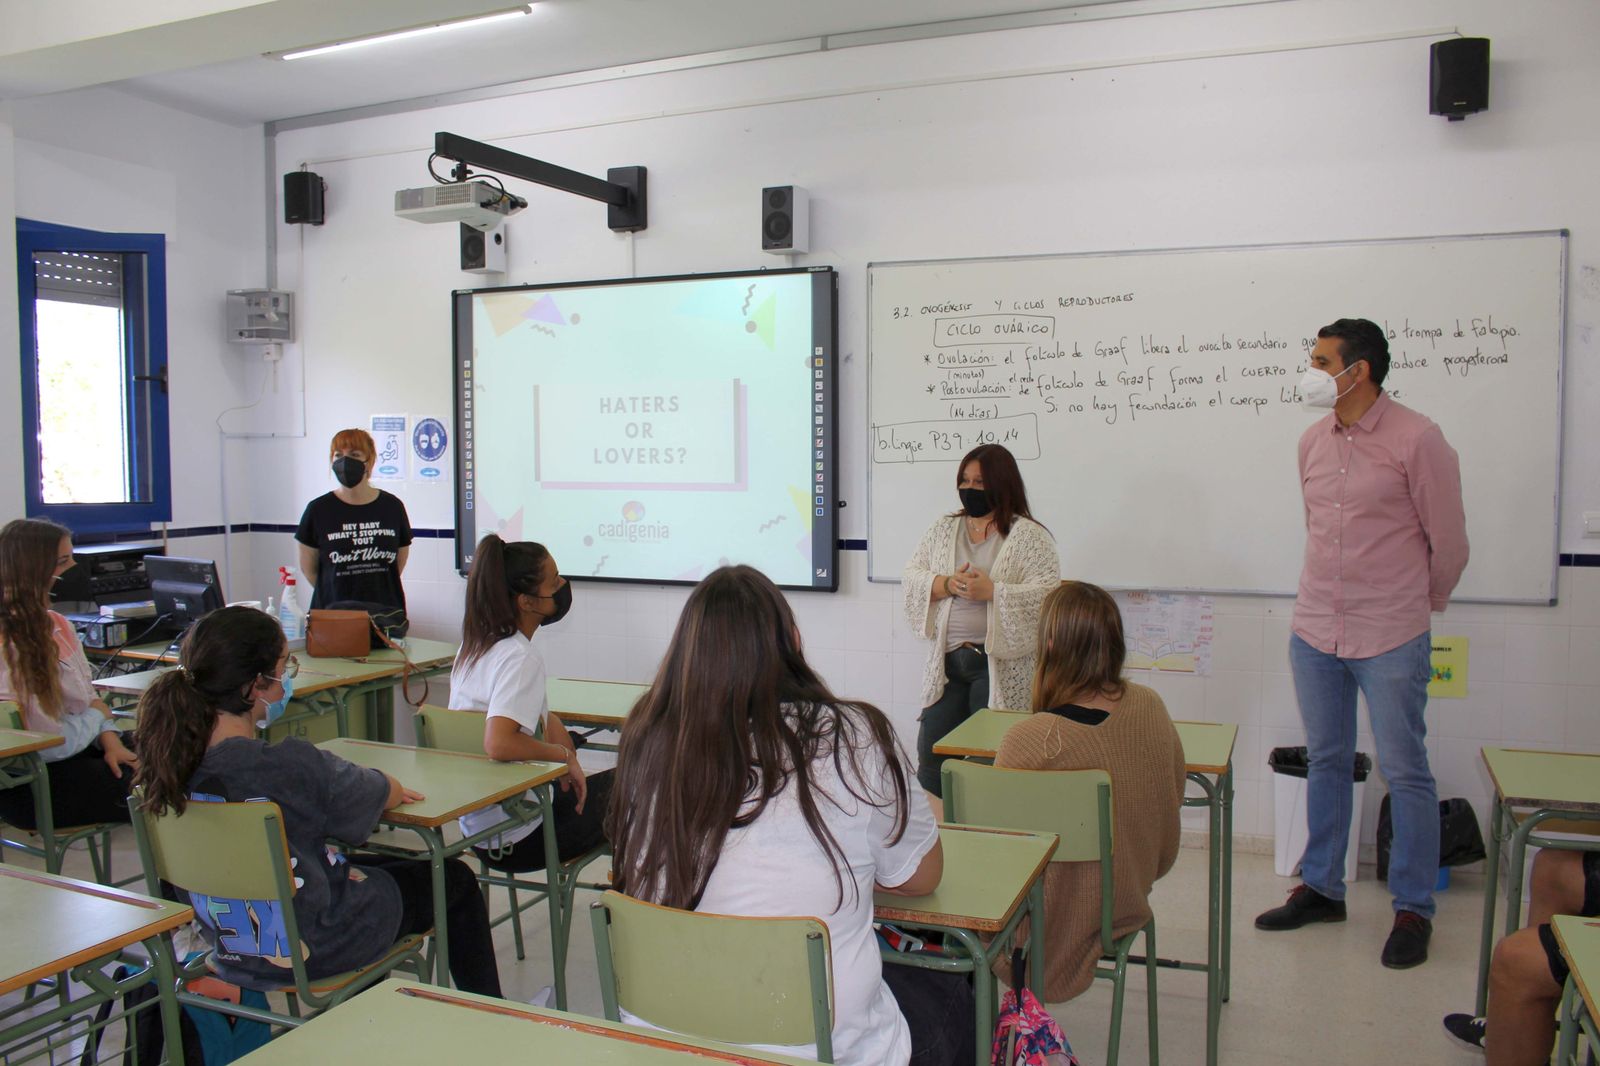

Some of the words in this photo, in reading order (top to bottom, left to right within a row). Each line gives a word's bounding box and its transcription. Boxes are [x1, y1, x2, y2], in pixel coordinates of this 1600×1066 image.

[1057, 292, 1135, 308] REPRODUCTORES
[946, 323, 982, 336] CICLO
[1004, 349, 1015, 365] el
[1071, 341, 1083, 358] de
[1094, 336, 1128, 366] Graaf
[1177, 334, 1189, 353] el
[1402, 318, 1443, 350] trompa
[1453, 319, 1465, 338] de
[1095, 370, 1109, 387] de
[1117, 366, 1155, 392] Graaf
[1216, 366, 1228, 383] el
[1241, 366, 1287, 378] CUERPO
[1387, 351, 1429, 381] roduce
[599, 395, 680, 414] HATERS
[1068, 402, 1084, 413] no
[1092, 394, 1118, 425] hay
[1208, 390, 1222, 407] el
[625, 421, 654, 439] OR
[593, 447, 688, 464] LOVERS?
[327, 531, 358, 541] WHAT'S
[359, 529, 396, 537] STOPPING
[342, 523, 357, 531] HEY
[359, 521, 380, 530] BABY
[598, 519, 670, 543] cadigenia
[352, 536, 374, 545] YOU?
[328, 549, 361, 564] Don't
[360, 546, 397, 564] Worry
